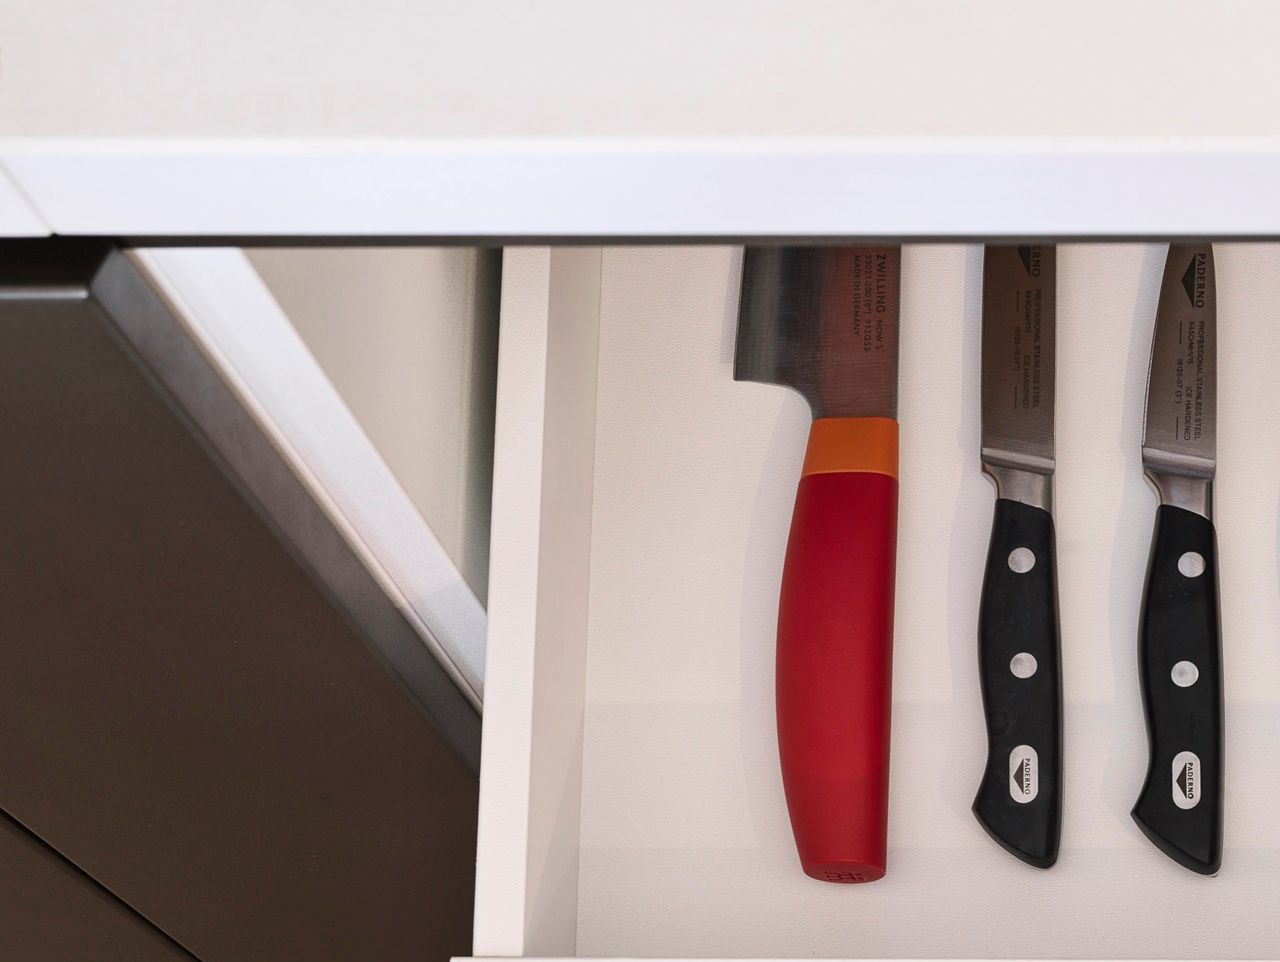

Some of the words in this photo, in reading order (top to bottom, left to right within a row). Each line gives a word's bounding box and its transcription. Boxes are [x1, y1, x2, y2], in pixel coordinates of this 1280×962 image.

[853, 255, 861, 278] MADE
[1031, 246, 1041, 277] ERNO
[853, 281, 861, 291] IN
[876, 254, 886, 313] ZWILLING
[1195, 253, 1206, 308] PADERNO
[852, 293, 861, 336] GERMANY
[875, 319, 884, 342] NOW
[1196, 320, 1205, 376] PROFESSIONAL
[1032, 385, 1040, 409] STEEL
[1185, 386, 1193, 398] ICE
[1195, 377, 1203, 416] STAINLESS
[1184, 400, 1192, 440] HARDENED
[1194, 418, 1202, 440] STEEL
